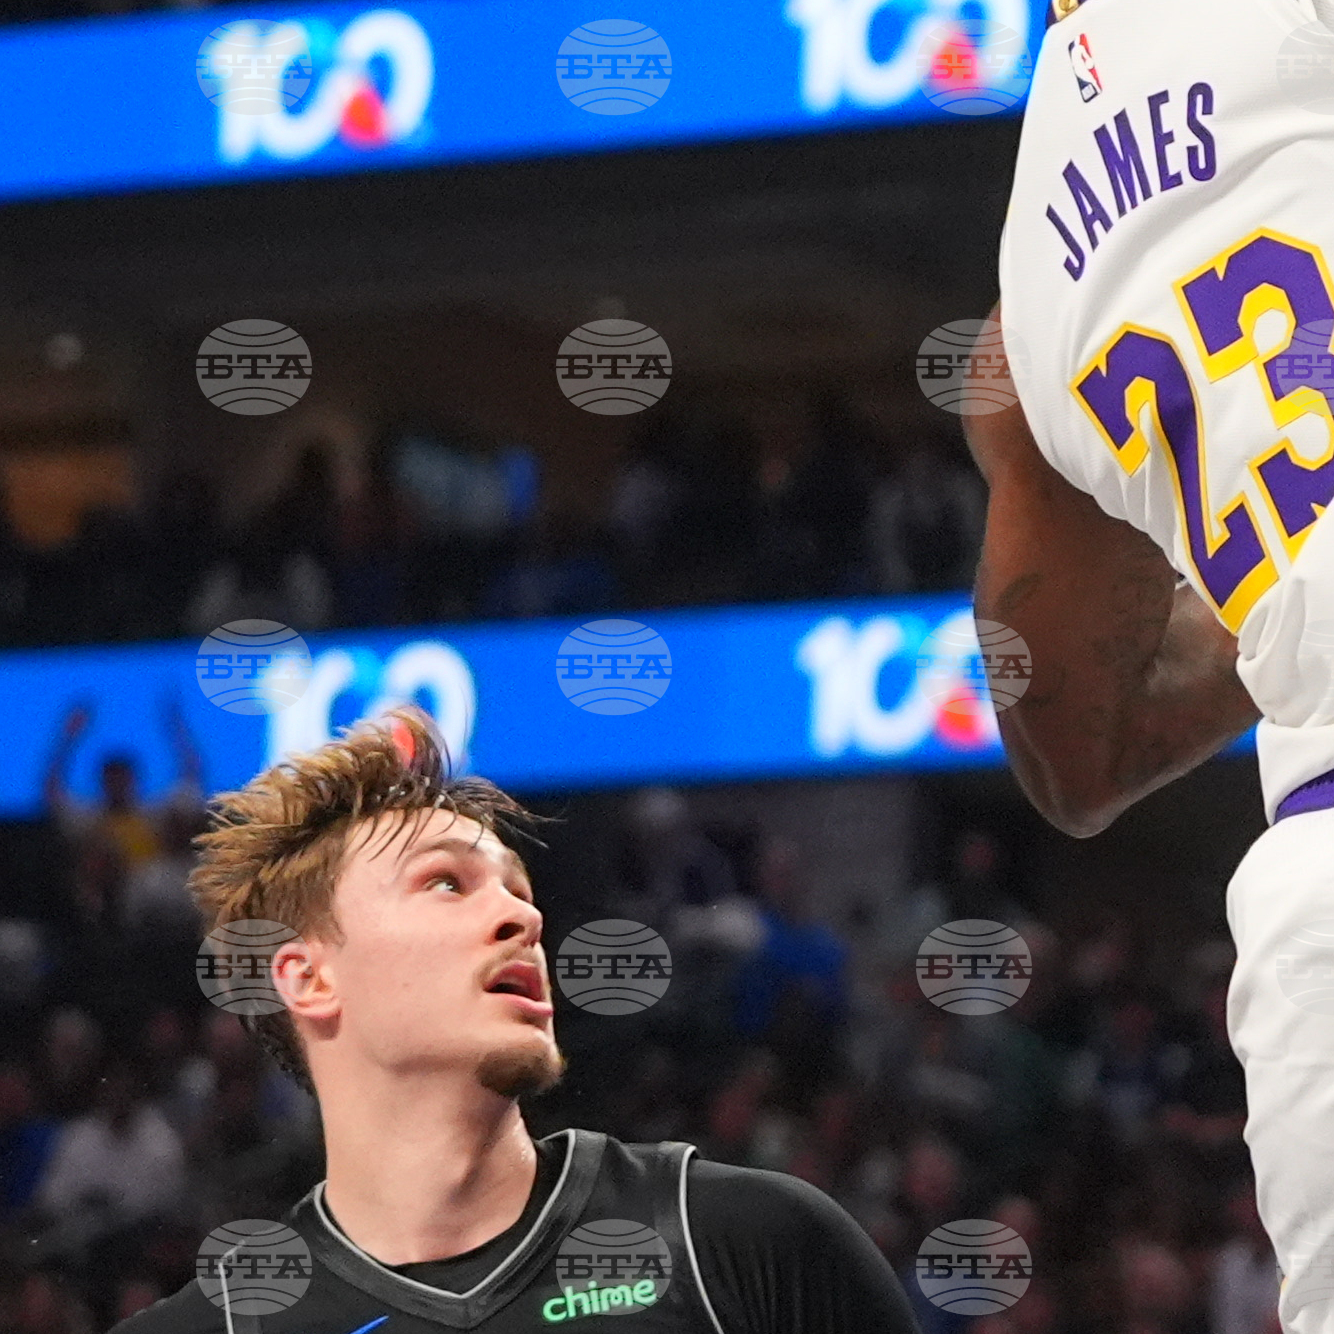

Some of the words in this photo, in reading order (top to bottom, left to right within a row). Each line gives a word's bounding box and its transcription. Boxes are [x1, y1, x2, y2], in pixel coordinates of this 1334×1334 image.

[202, 9, 433, 165] 100
[1045, 81, 1218, 282] JAMES
[542, 1279, 657, 1323] chime
